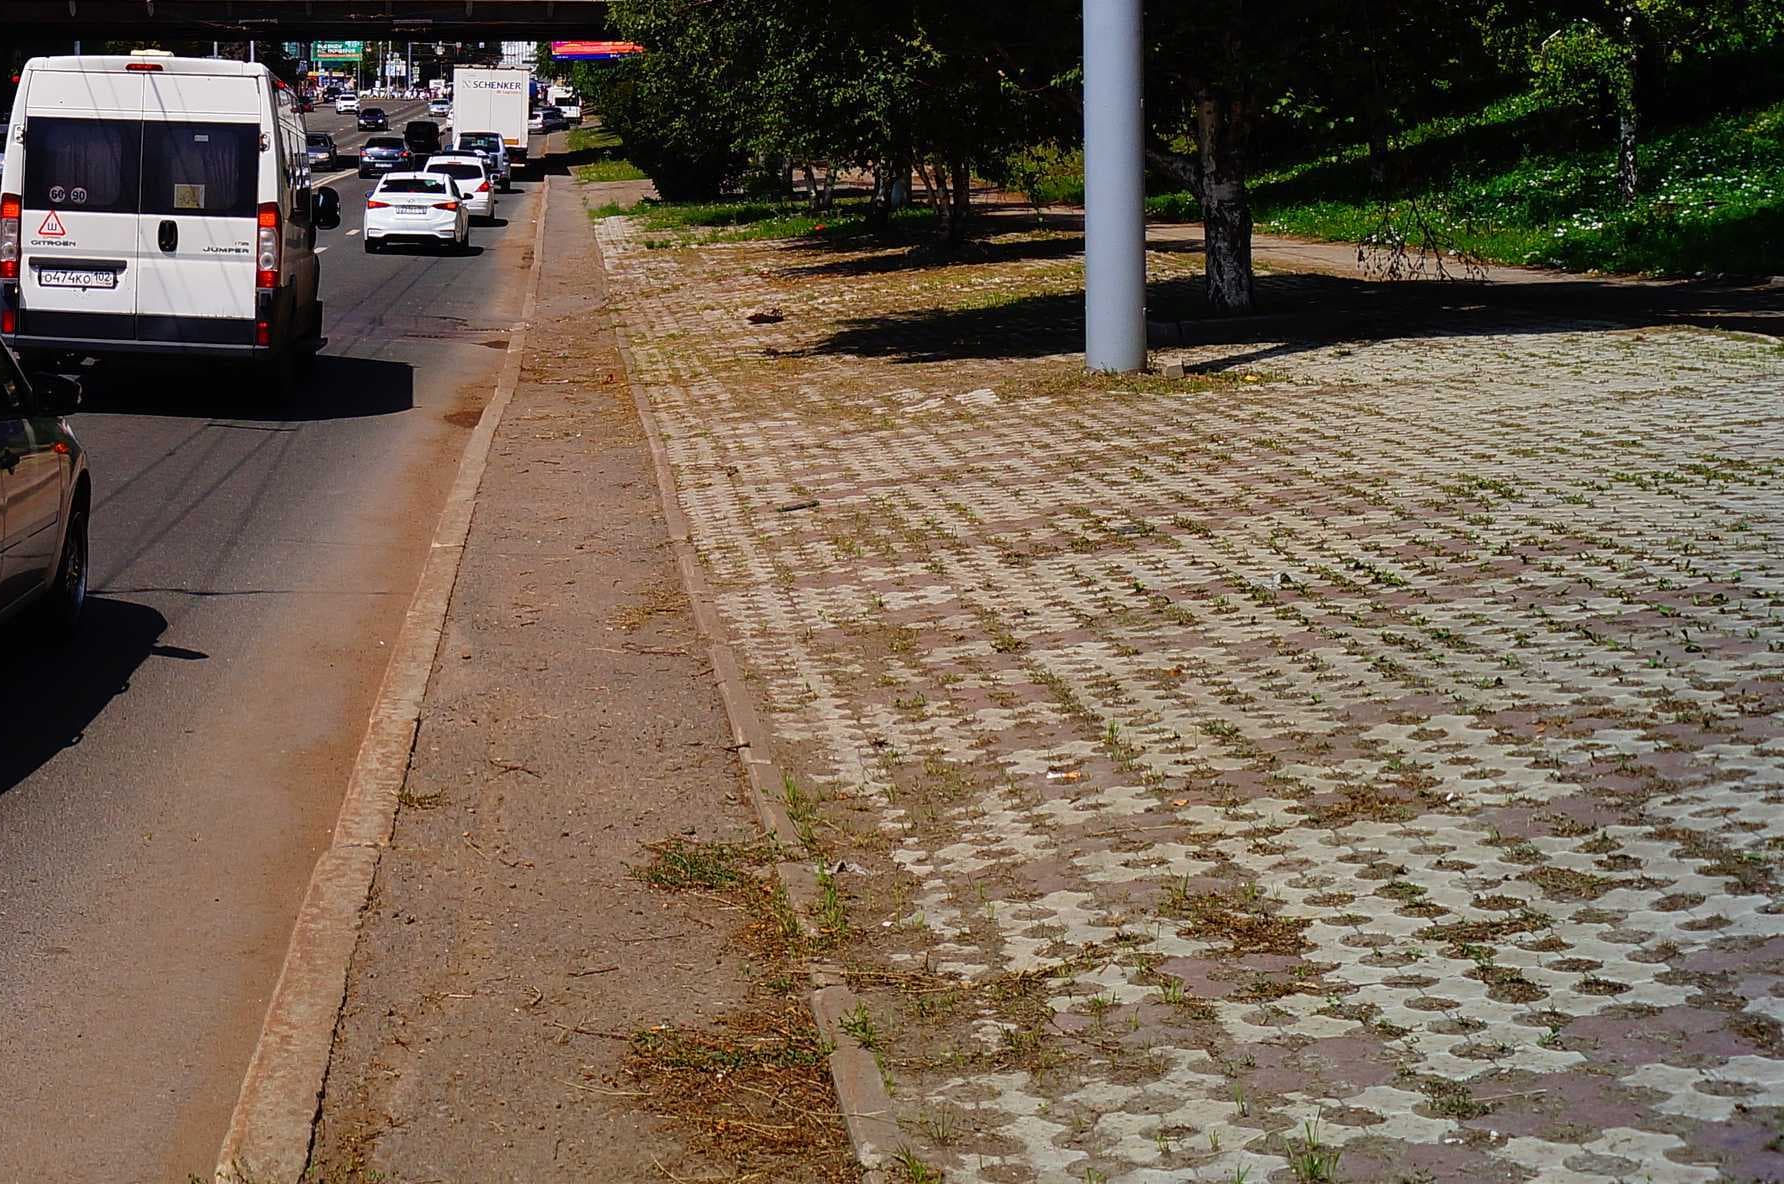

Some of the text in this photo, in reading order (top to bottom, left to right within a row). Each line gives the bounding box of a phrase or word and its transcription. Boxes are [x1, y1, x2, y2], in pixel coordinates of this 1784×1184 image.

[472, 80, 521, 90] SCHENKER
[51, 188, 65, 200] 60
[72, 189, 85, 201] 90
[47, 222, 57, 231] Ш
[202, 246, 249, 254] JUMPER
